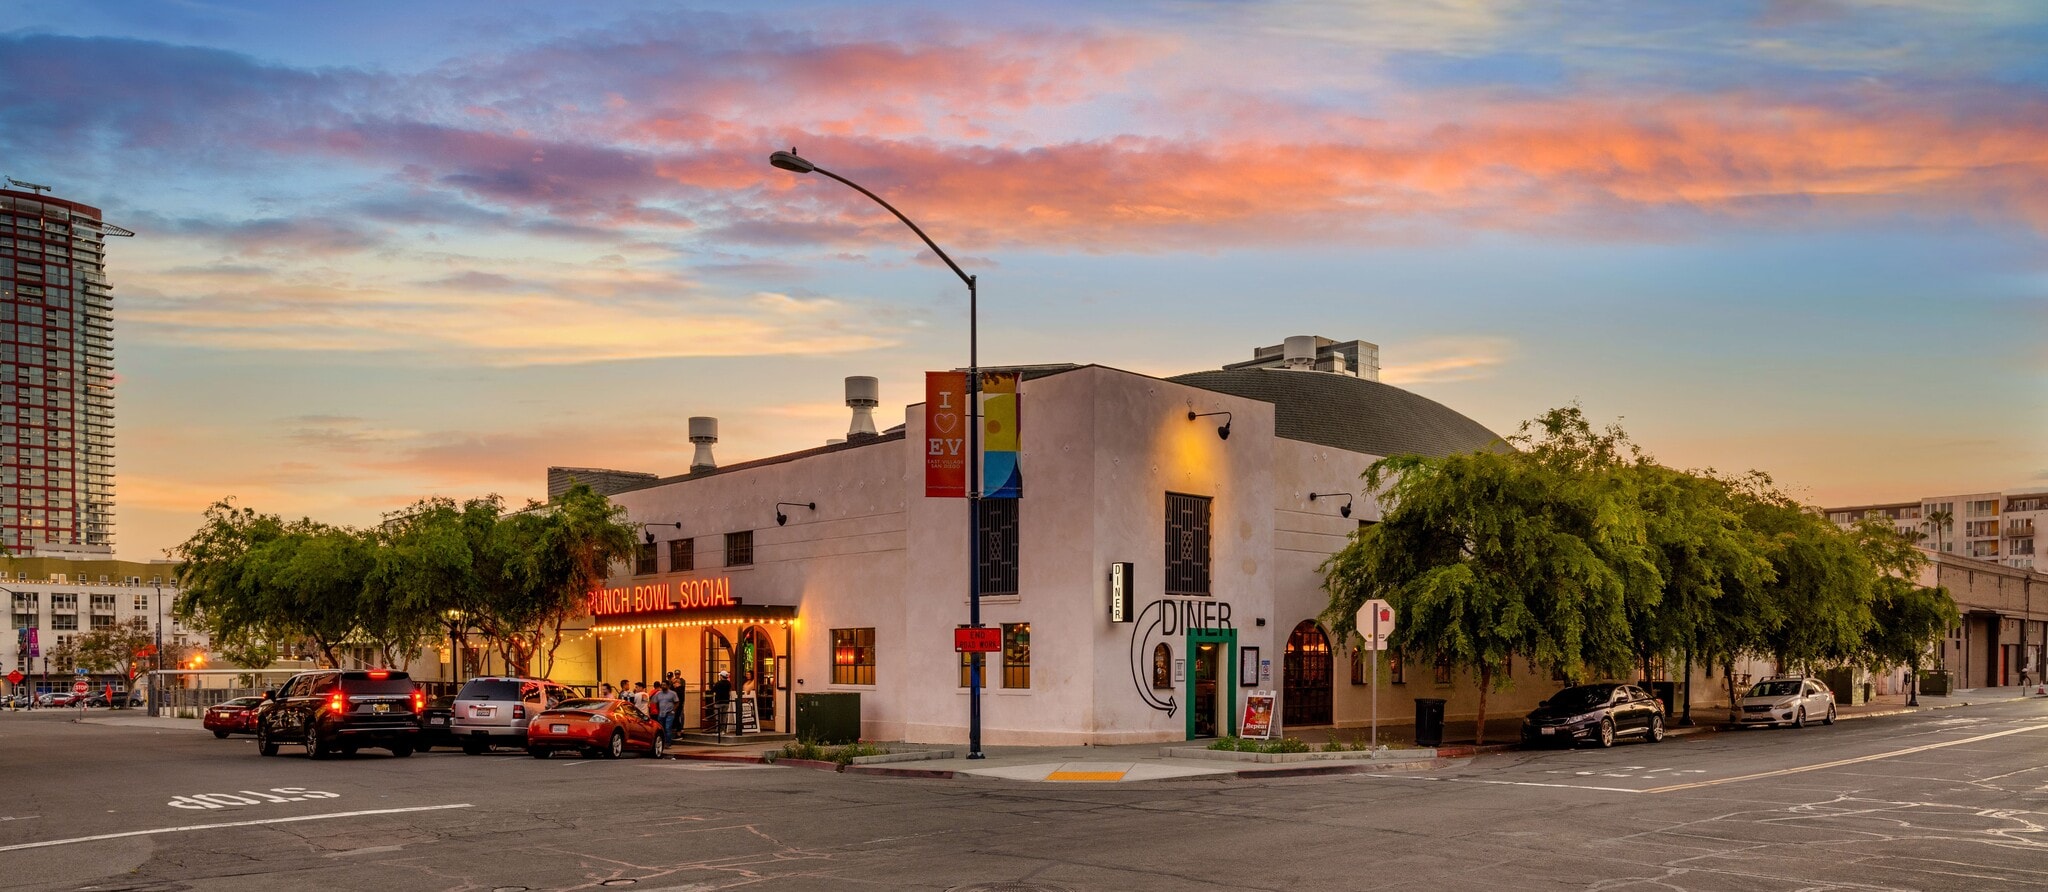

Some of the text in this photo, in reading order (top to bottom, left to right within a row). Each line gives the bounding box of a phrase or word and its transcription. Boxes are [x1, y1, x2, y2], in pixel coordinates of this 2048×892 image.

[939, 391, 952, 408] I
[928, 438, 963, 456] EV
[587, 578, 735, 616] PUNCH BOWL SOCIAL
[1162, 600, 1233, 636] DINER
[970, 631, 986, 639] END
[959, 641, 997, 649] ROAD WORK
[1246, 722, 1268, 730] Repeat
[167, 787, 341, 810] STOP
